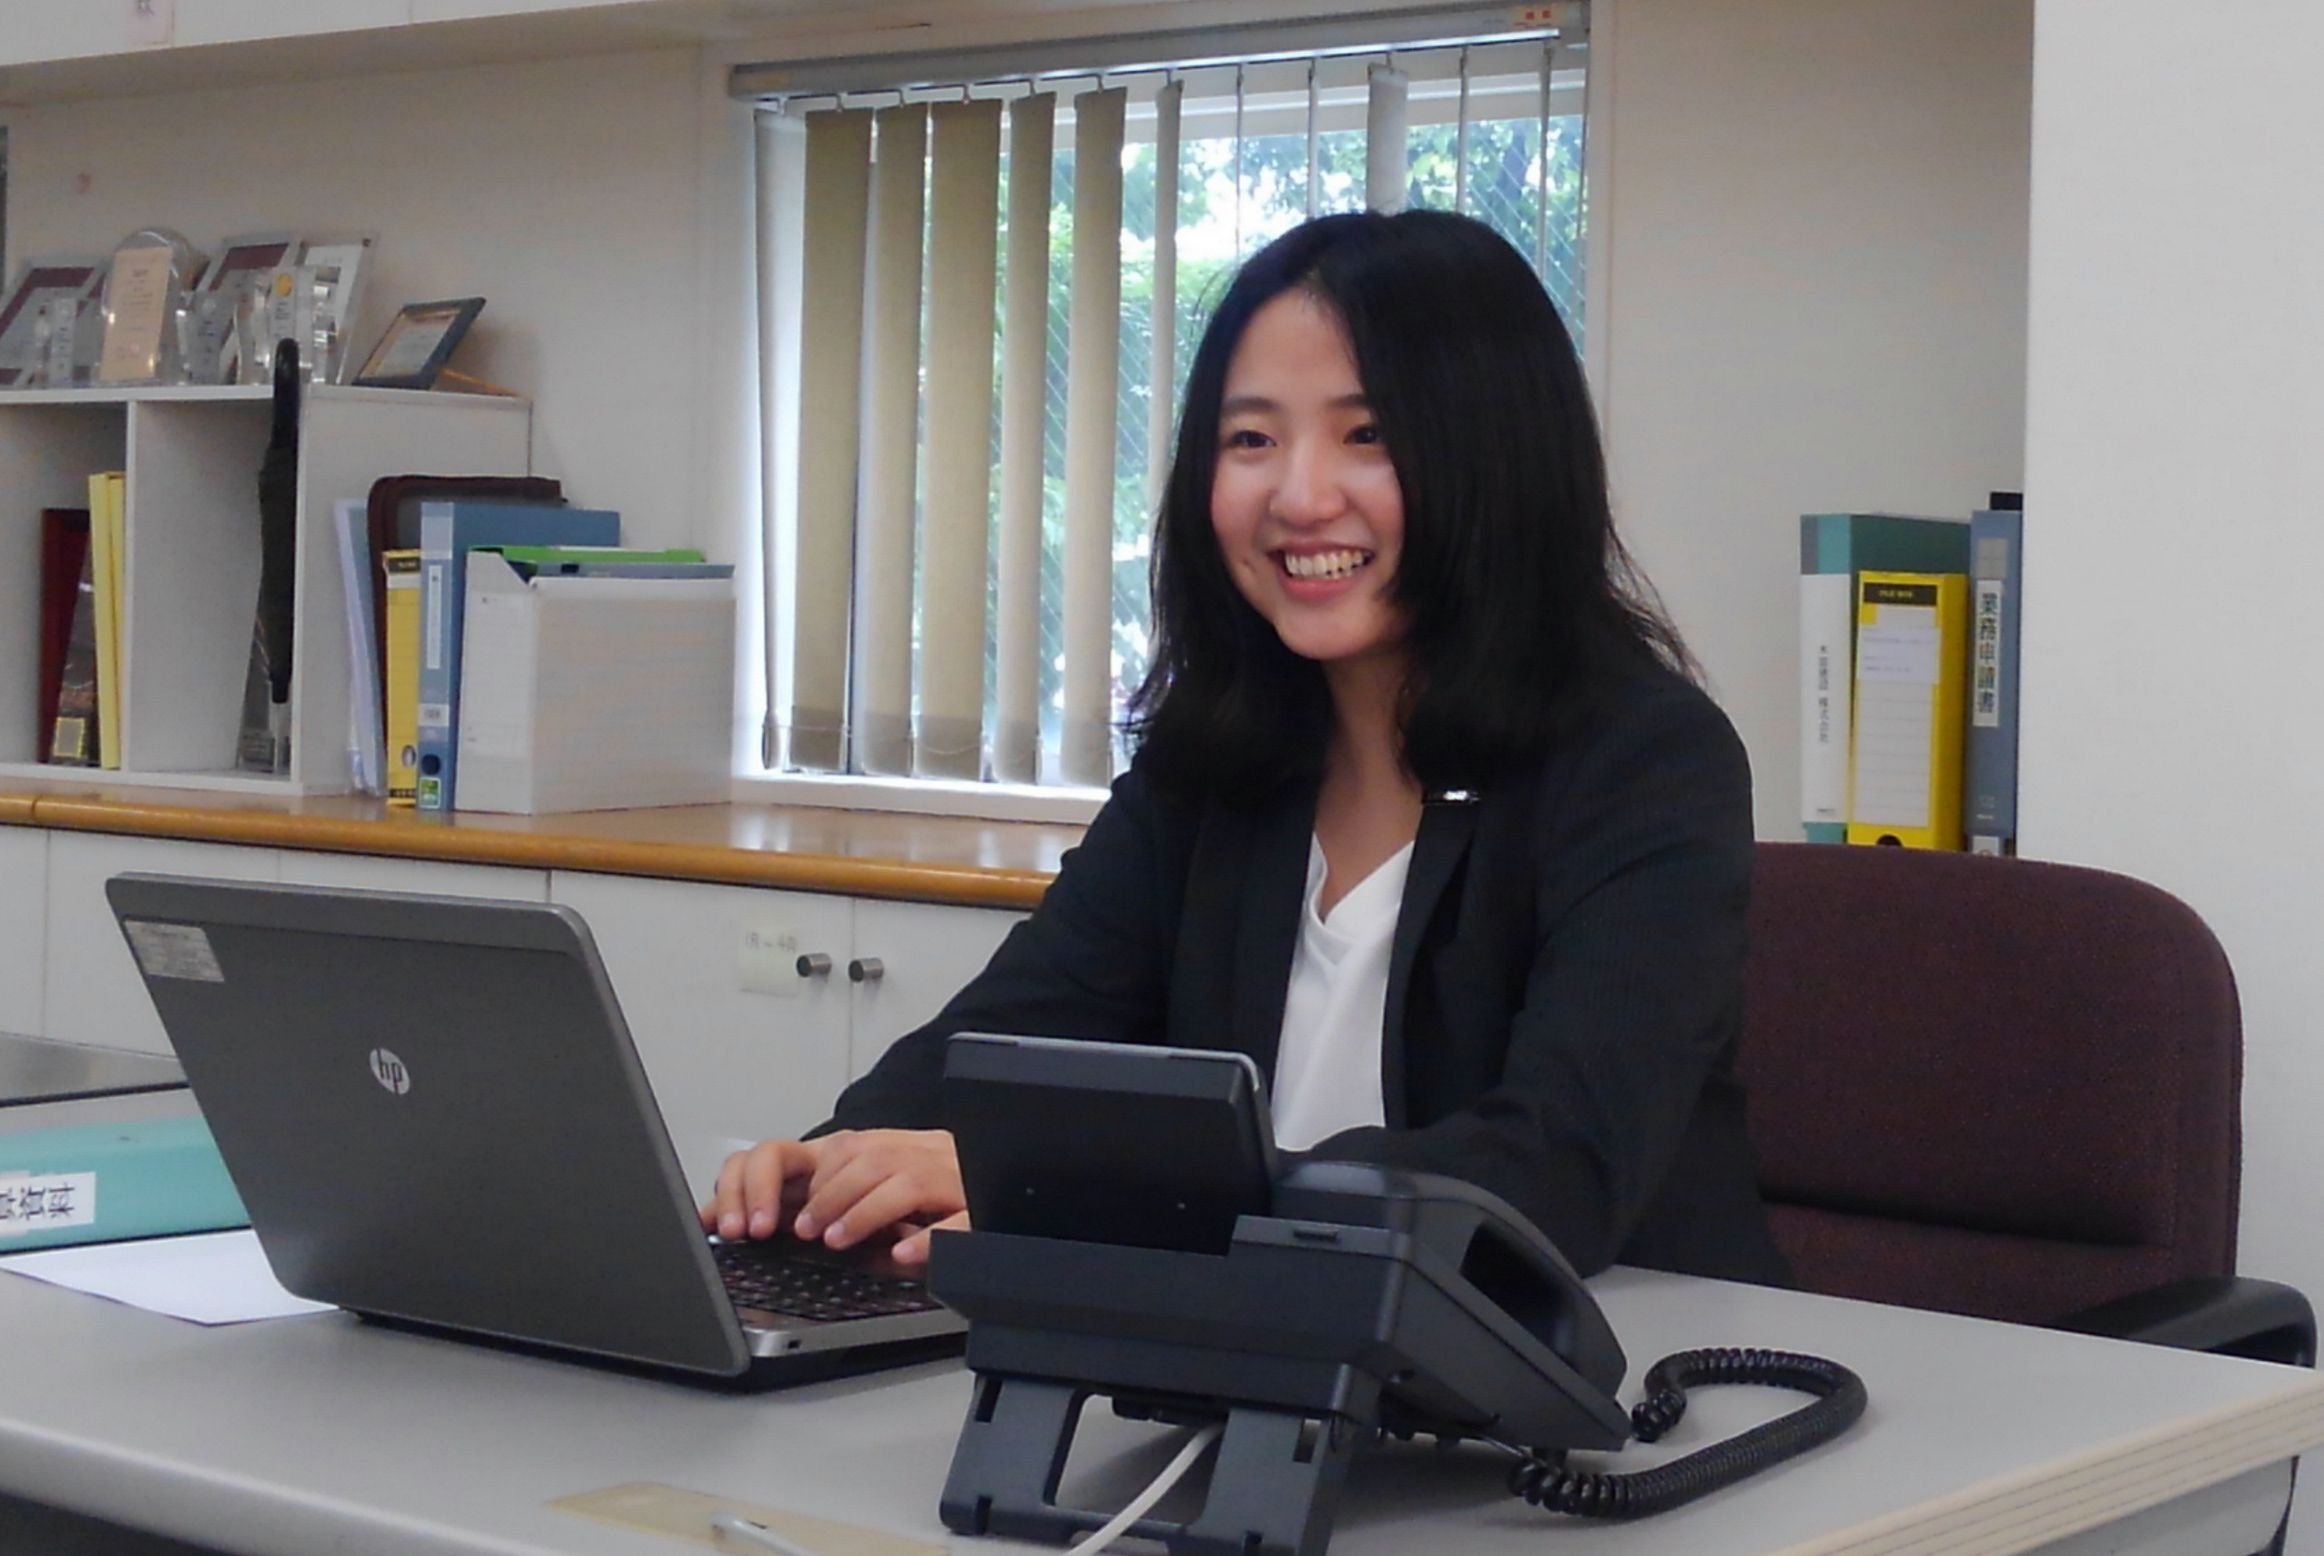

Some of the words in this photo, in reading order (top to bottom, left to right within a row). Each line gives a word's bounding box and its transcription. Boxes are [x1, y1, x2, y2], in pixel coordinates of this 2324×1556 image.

[1978, 592, 1998, 714] 業務申請書
[373, 1047, 406, 1096] hp
